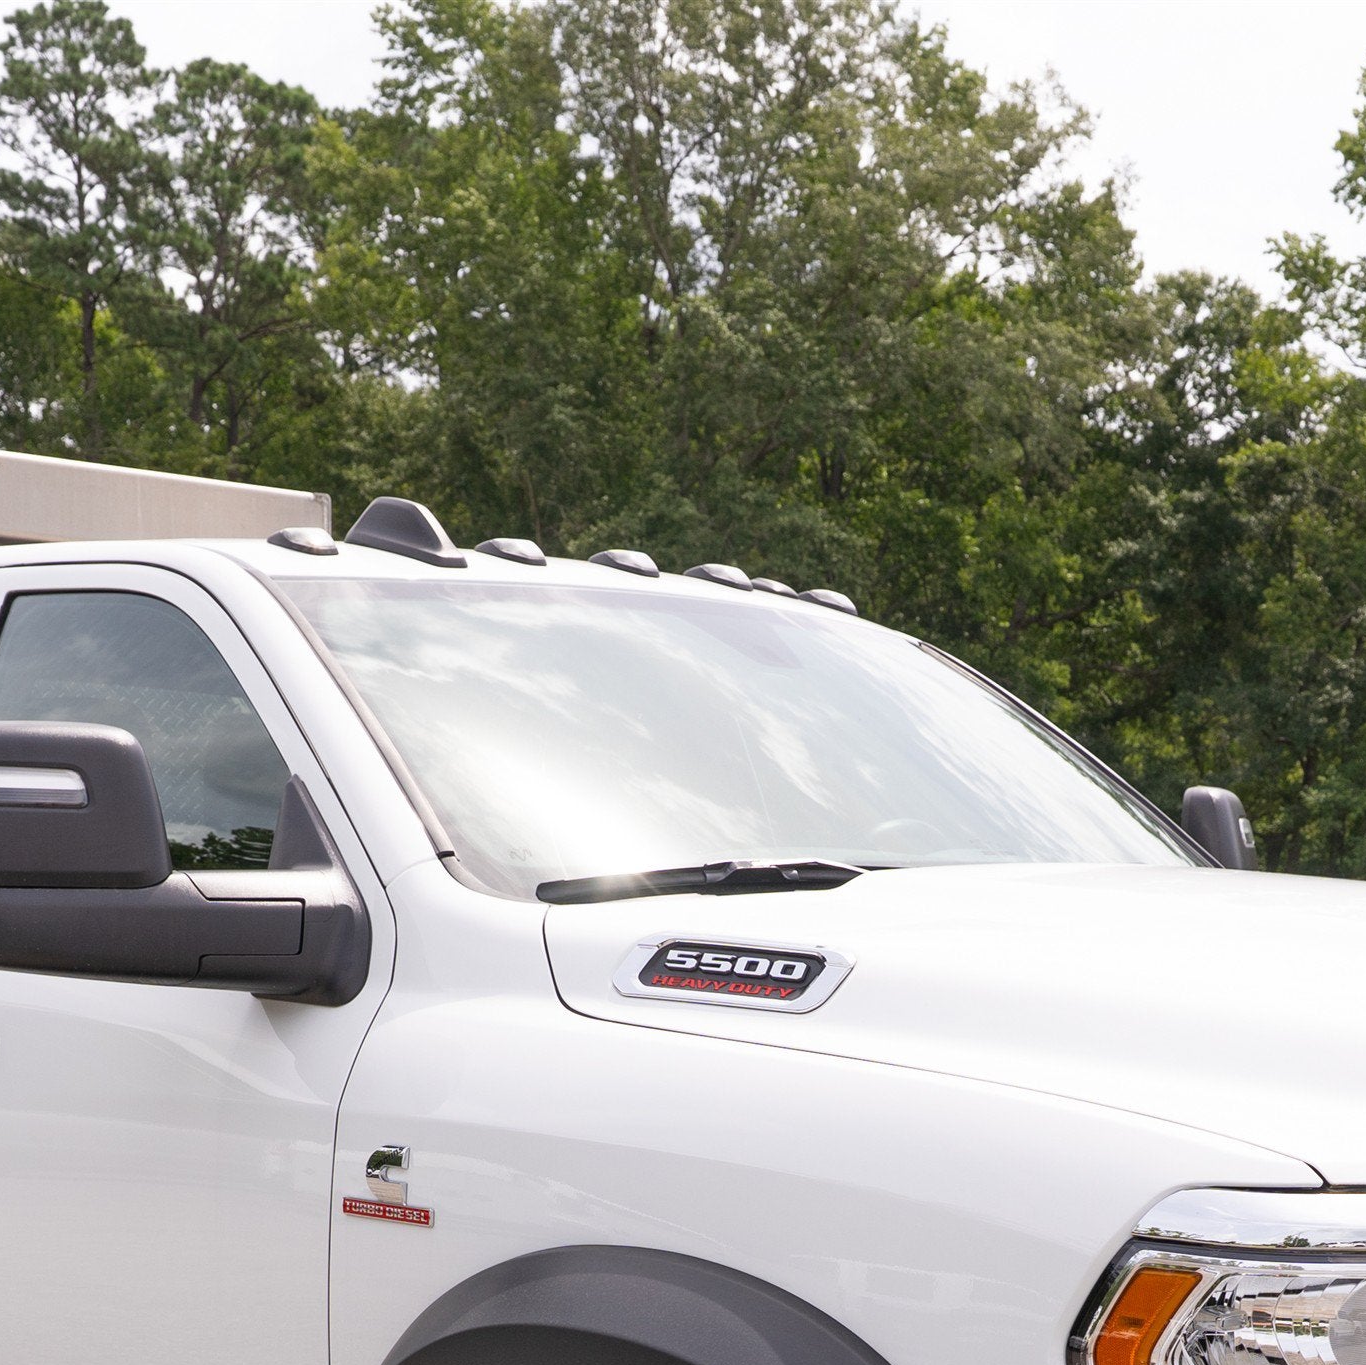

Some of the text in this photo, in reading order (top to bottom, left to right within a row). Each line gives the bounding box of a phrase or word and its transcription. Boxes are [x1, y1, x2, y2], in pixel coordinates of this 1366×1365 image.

[664, 949, 808, 983] 5500
[652, 975, 795, 998] HEAVY DUTY
[345, 1200, 428, 1223] TURBO DIESEL
